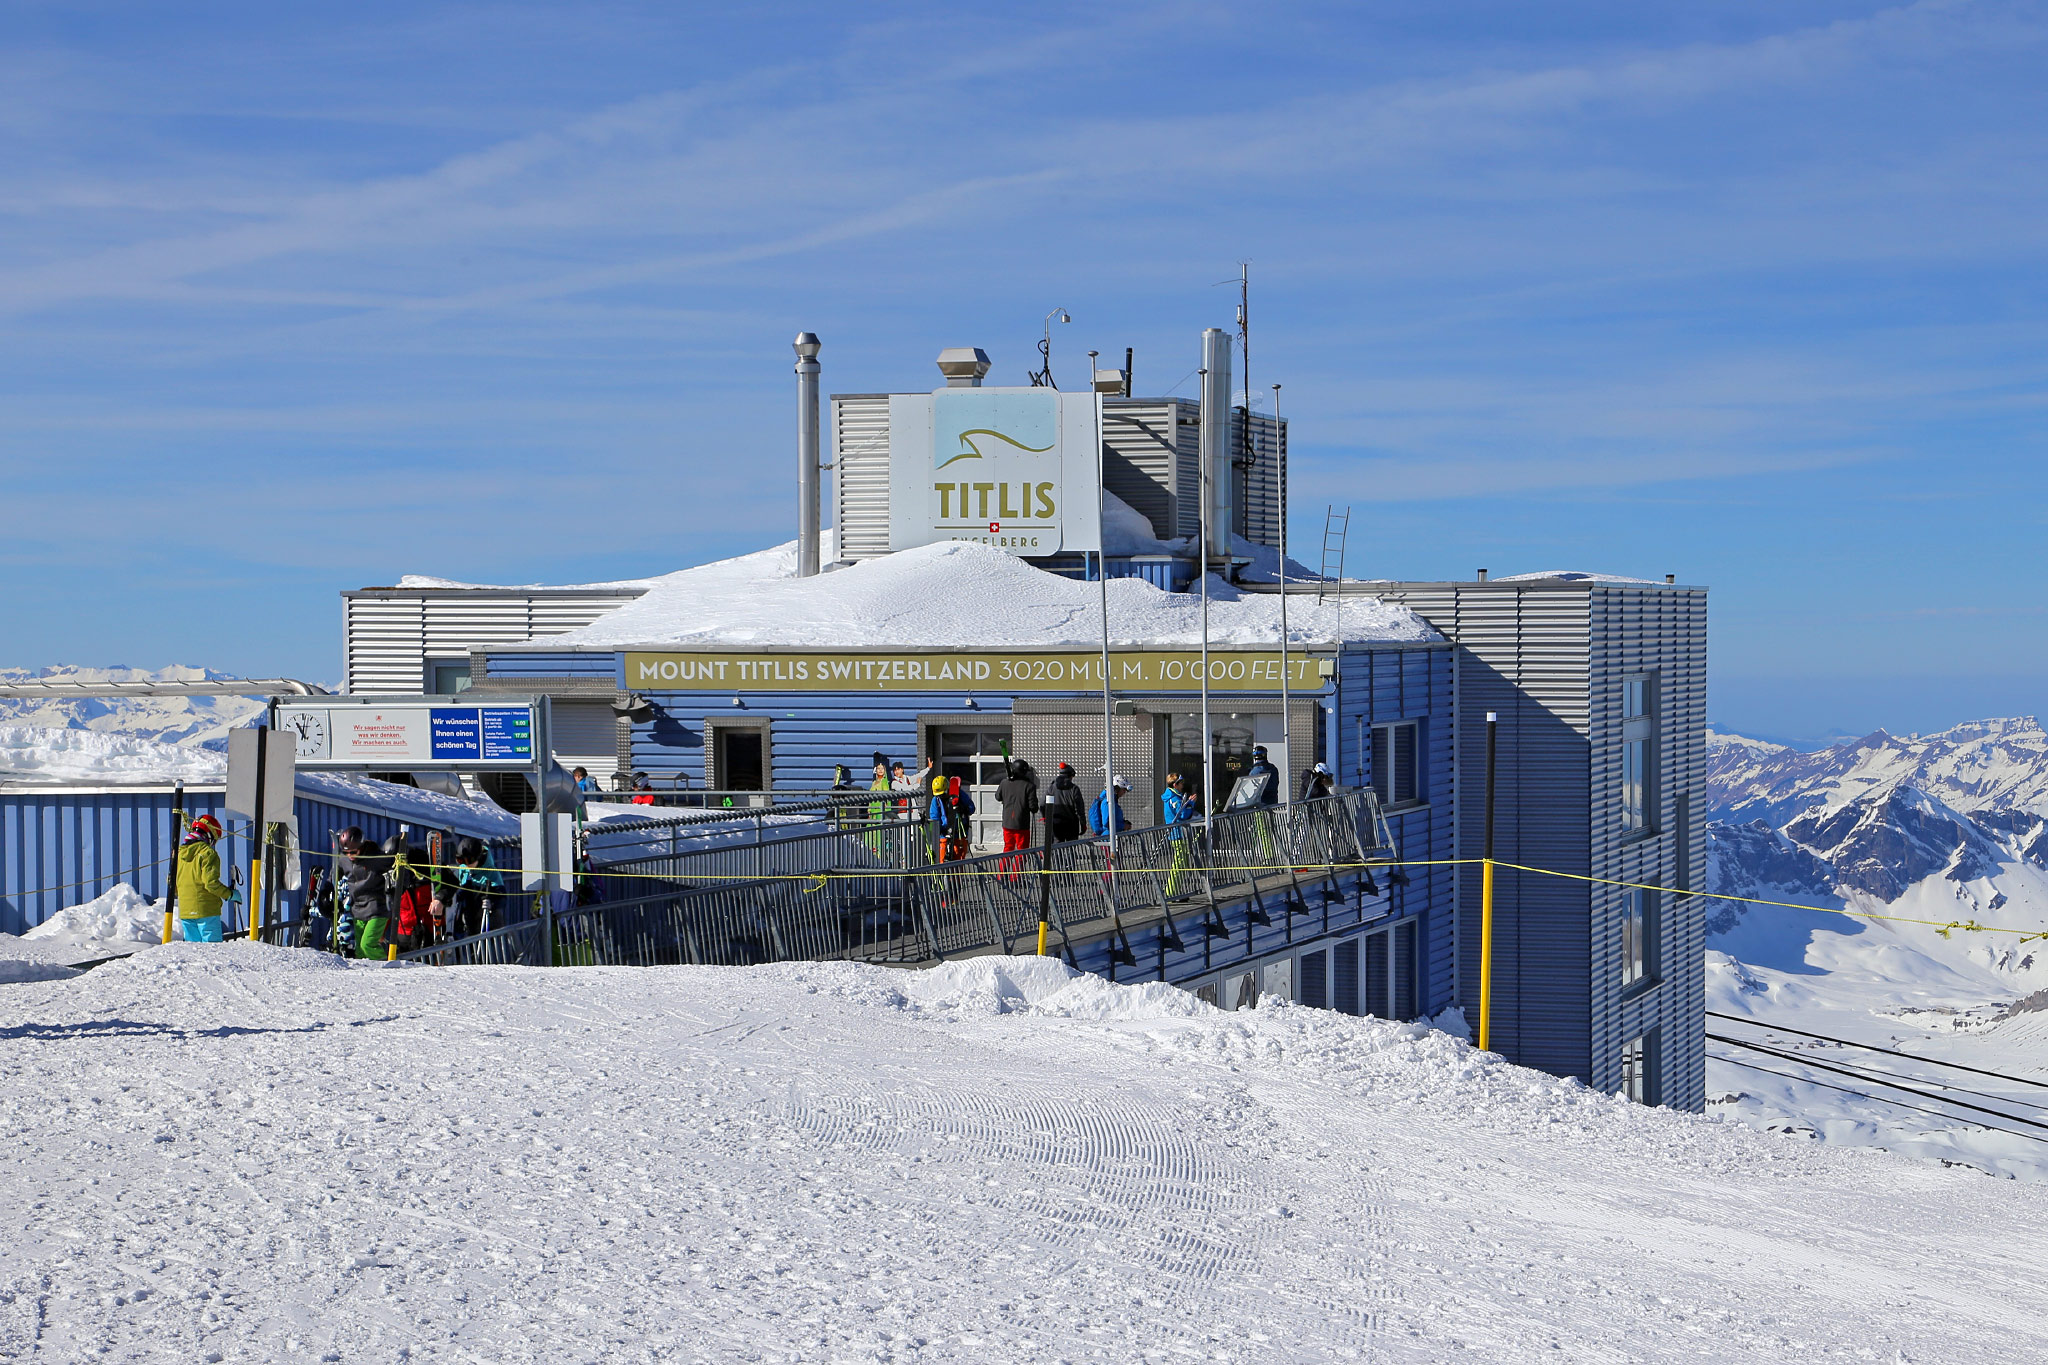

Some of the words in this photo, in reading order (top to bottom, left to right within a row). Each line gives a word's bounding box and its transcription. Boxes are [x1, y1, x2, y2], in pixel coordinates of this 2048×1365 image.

[934, 481, 1056, 519] TITLIS
[639, 661, 729, 680] MOUNT
[736, 661, 809, 680] TITLIS
[816, 660, 991, 681] SWITZERLAND
[998, 660, 1065, 681] 3020
[1070, 660, 1089, 681] M
[1251, 660, 1311, 681] FEET
[465, 741, 477, 750] Tag
